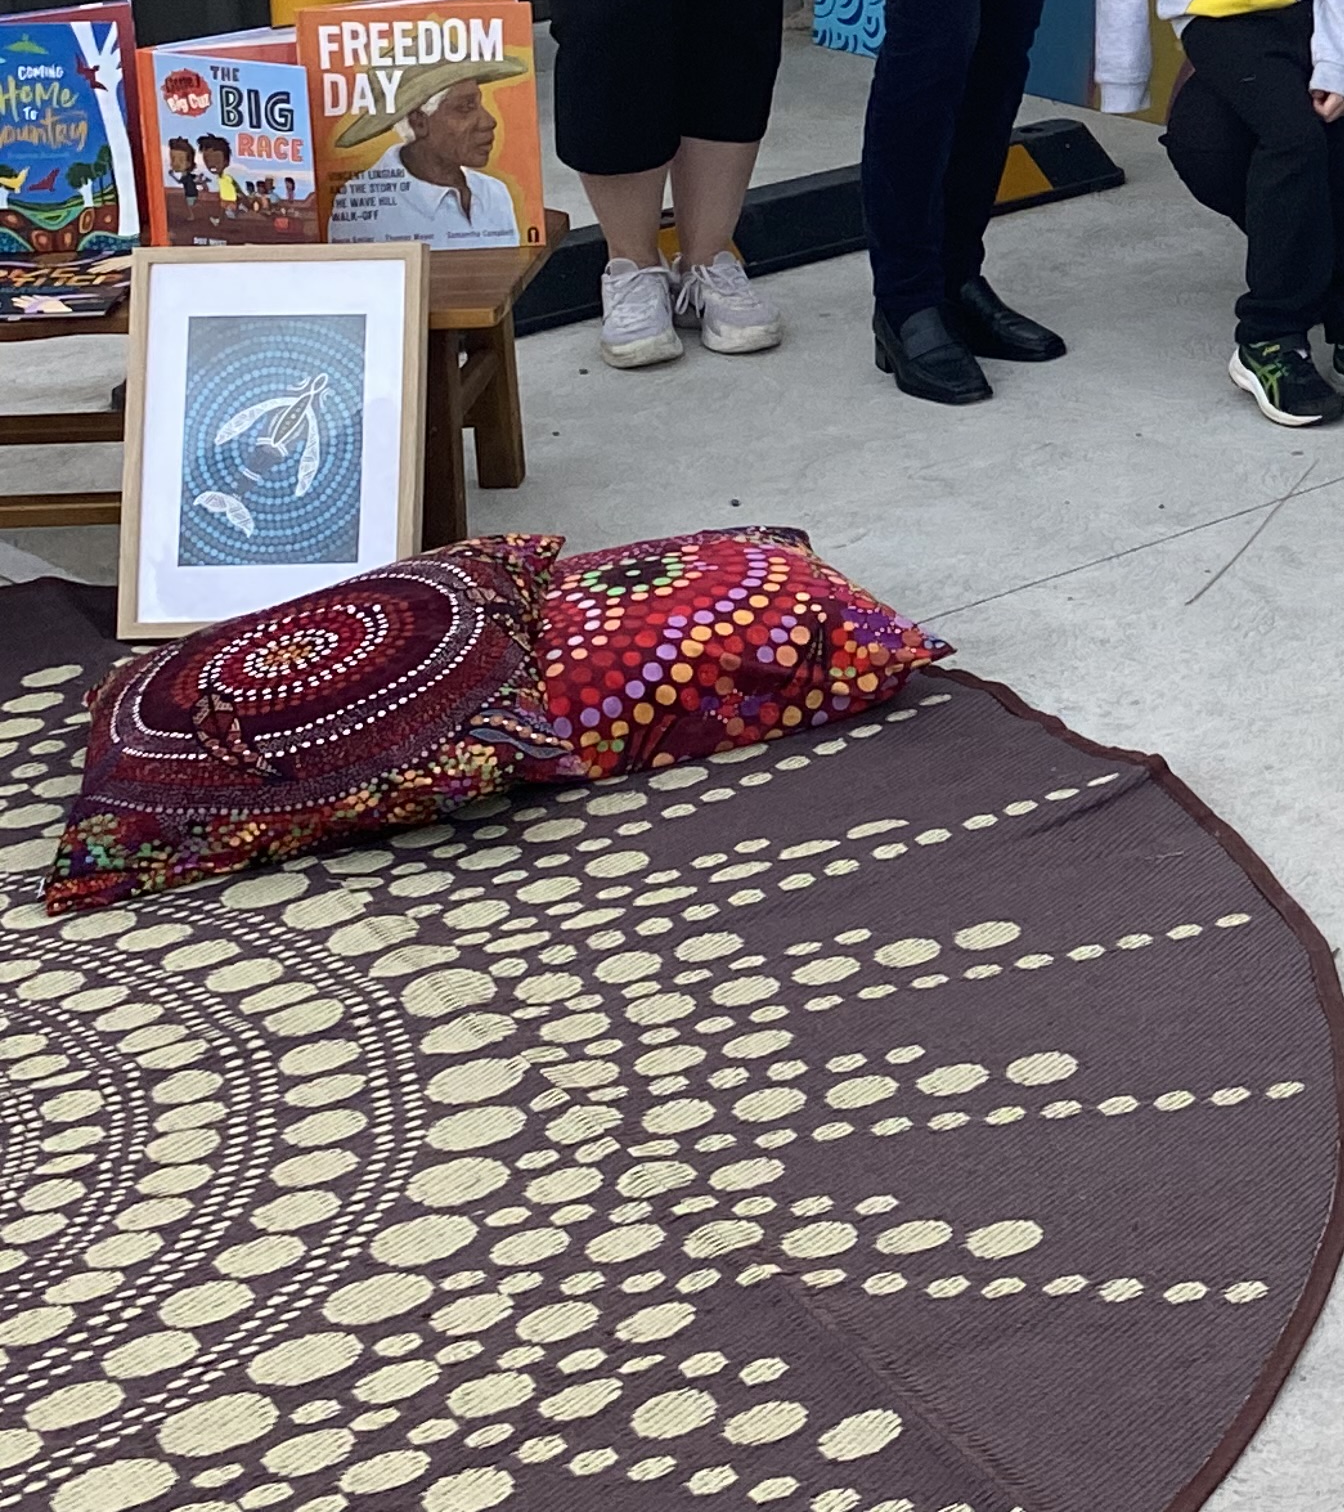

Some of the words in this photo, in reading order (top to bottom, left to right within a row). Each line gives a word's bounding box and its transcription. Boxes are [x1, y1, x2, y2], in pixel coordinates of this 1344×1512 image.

[318, 17, 504, 70] FREEDOM
[209, 65, 240, 82] THE
[322, 69, 403, 117] DAY
[219, 84, 294, 133] BIG
[237, 132, 304, 163] RACE
[349, 183, 367, 194] THE
[369, 182, 398, 194] STORY
[349, 196, 376, 207] WAVE
[331, 209, 379, 222] WALK-OFF
